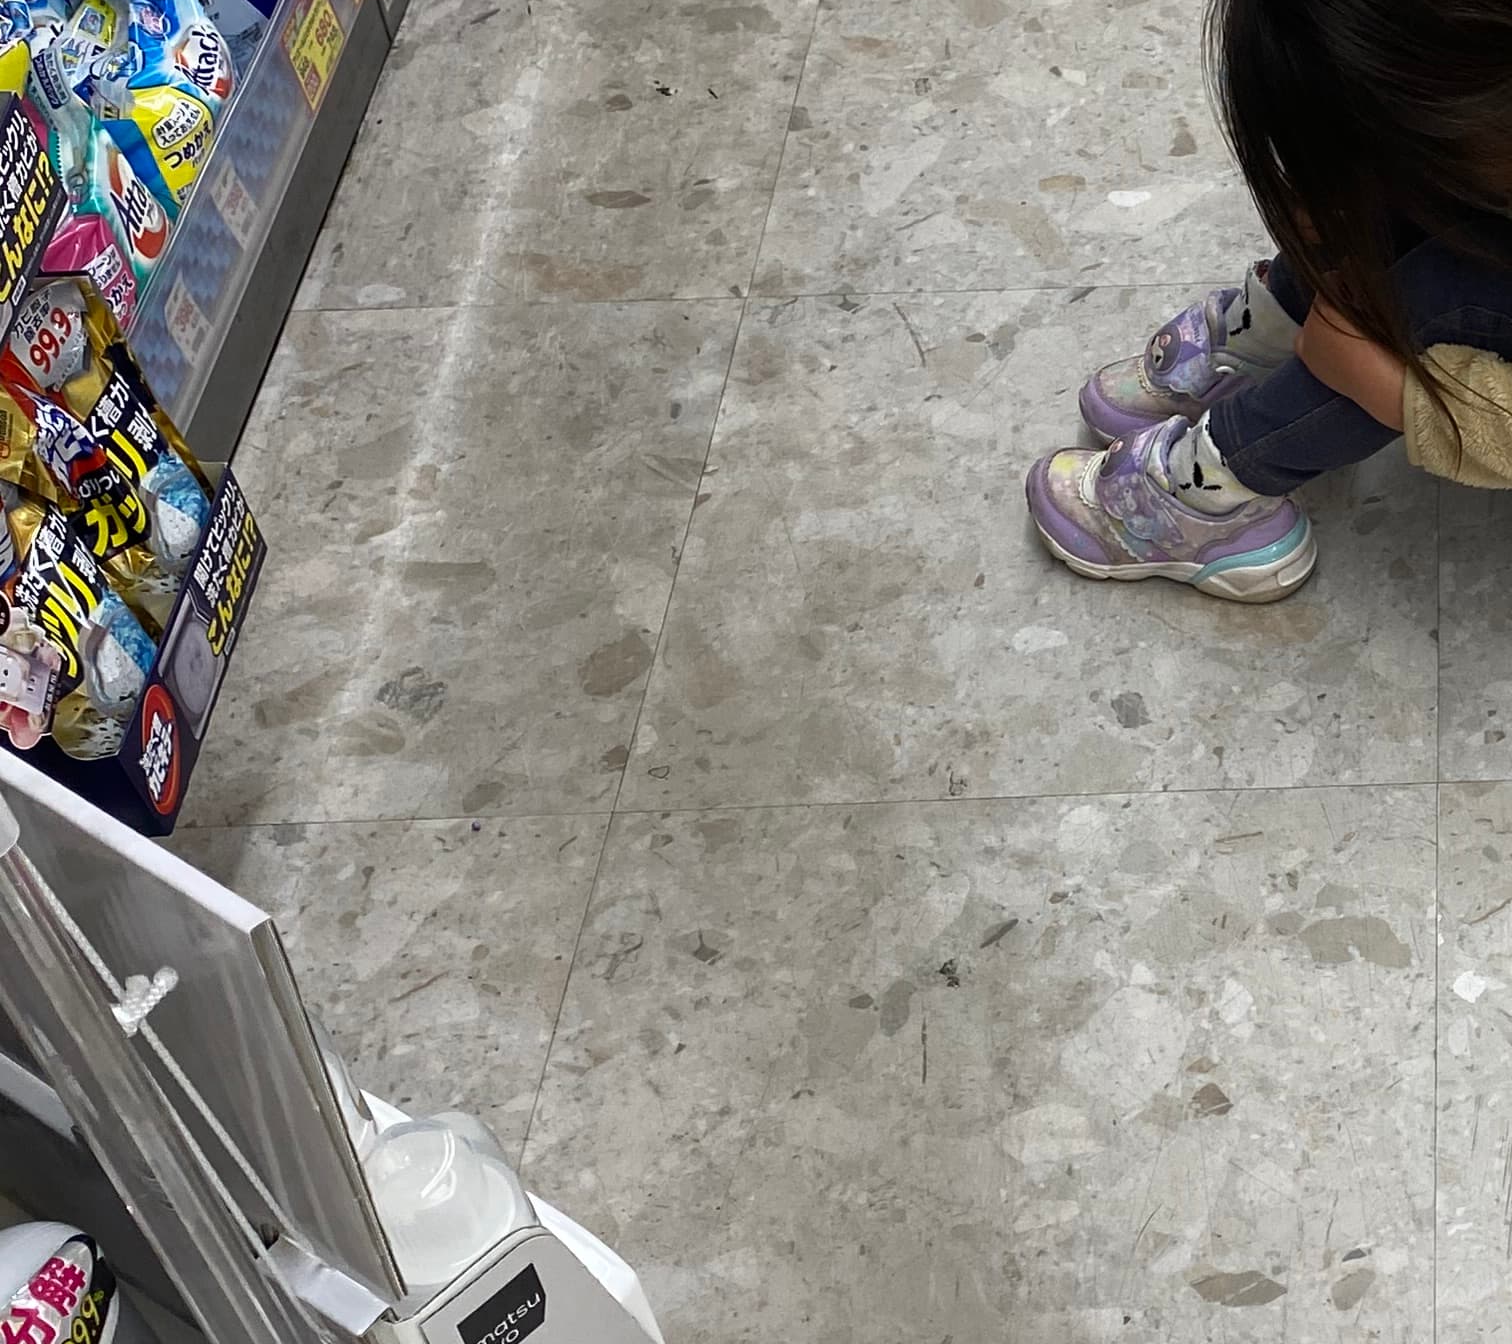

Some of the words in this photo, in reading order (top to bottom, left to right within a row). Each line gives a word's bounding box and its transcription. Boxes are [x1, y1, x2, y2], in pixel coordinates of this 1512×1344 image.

[194, 480, 239, 591] 開けてビックリ、
[207, 512, 260, 657] こんなに!?
